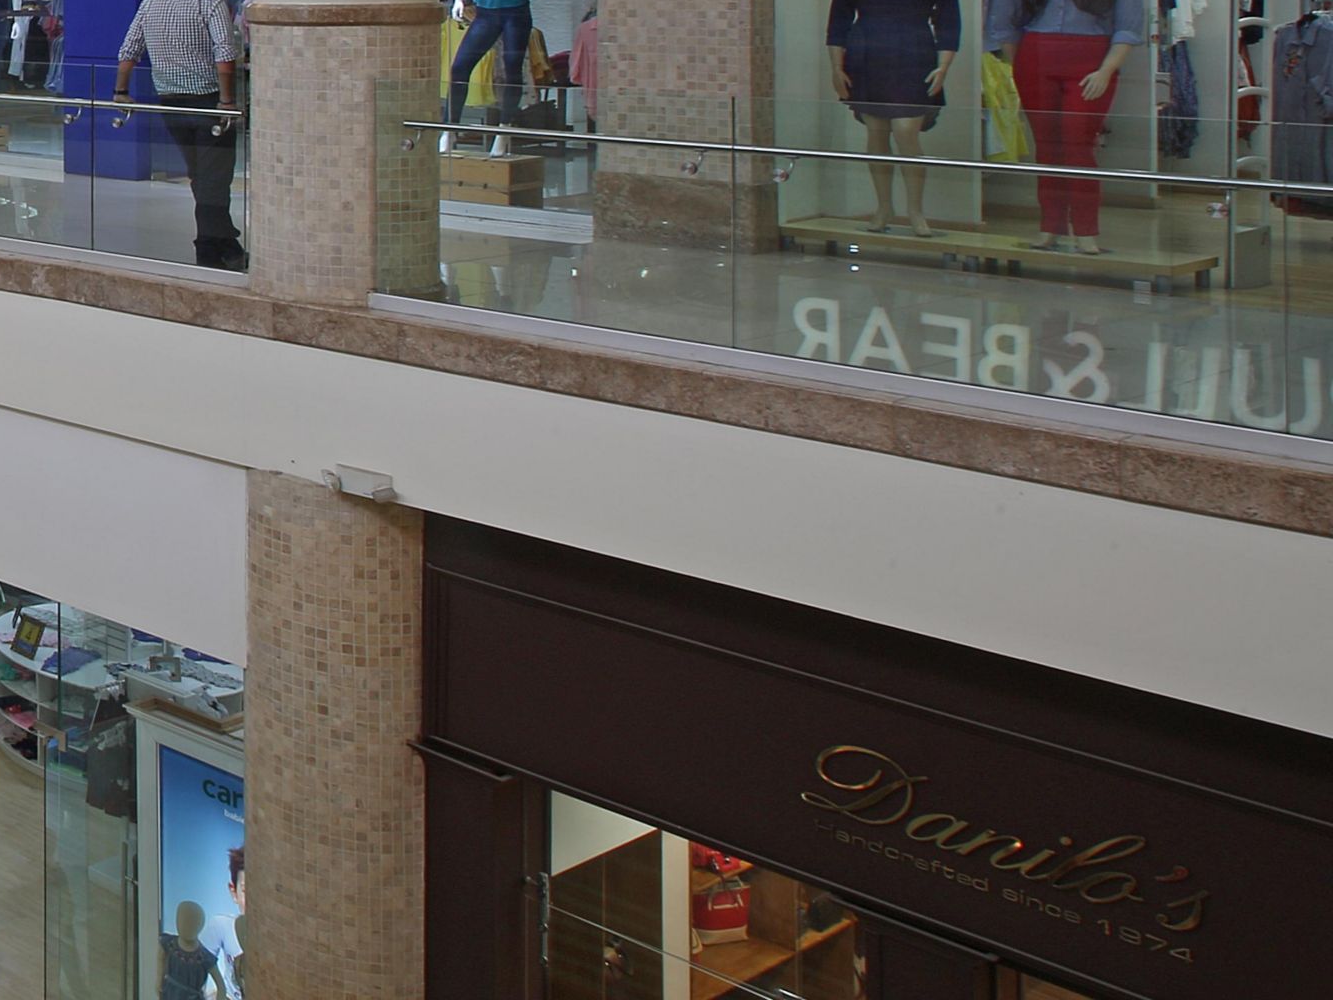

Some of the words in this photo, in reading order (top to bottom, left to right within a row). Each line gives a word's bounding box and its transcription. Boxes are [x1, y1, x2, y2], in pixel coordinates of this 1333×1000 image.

[800, 744, 1211, 932] Danilo's
[814, 819, 991, 893] Handcrafted
[1001, 887, 1084, 925] since
[1097, 919, 1195, 964] 1974
